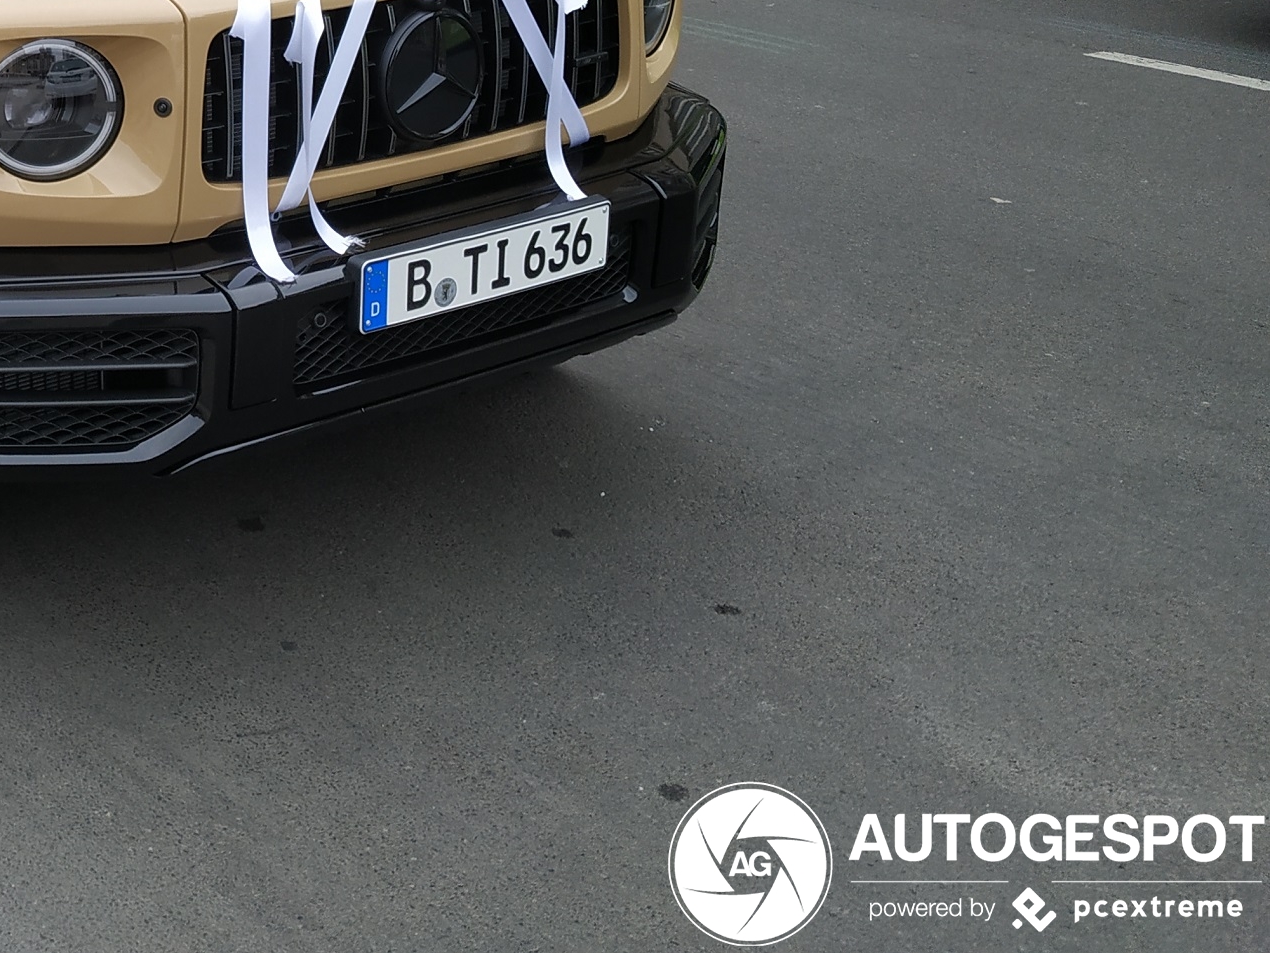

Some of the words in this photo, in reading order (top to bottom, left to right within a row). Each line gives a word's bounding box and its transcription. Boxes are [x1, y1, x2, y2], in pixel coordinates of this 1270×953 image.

[371, 302, 379, 317] D
[406, 259, 433, 312] B
[464, 238, 510, 295] TI
[524, 217, 591, 279] 636
